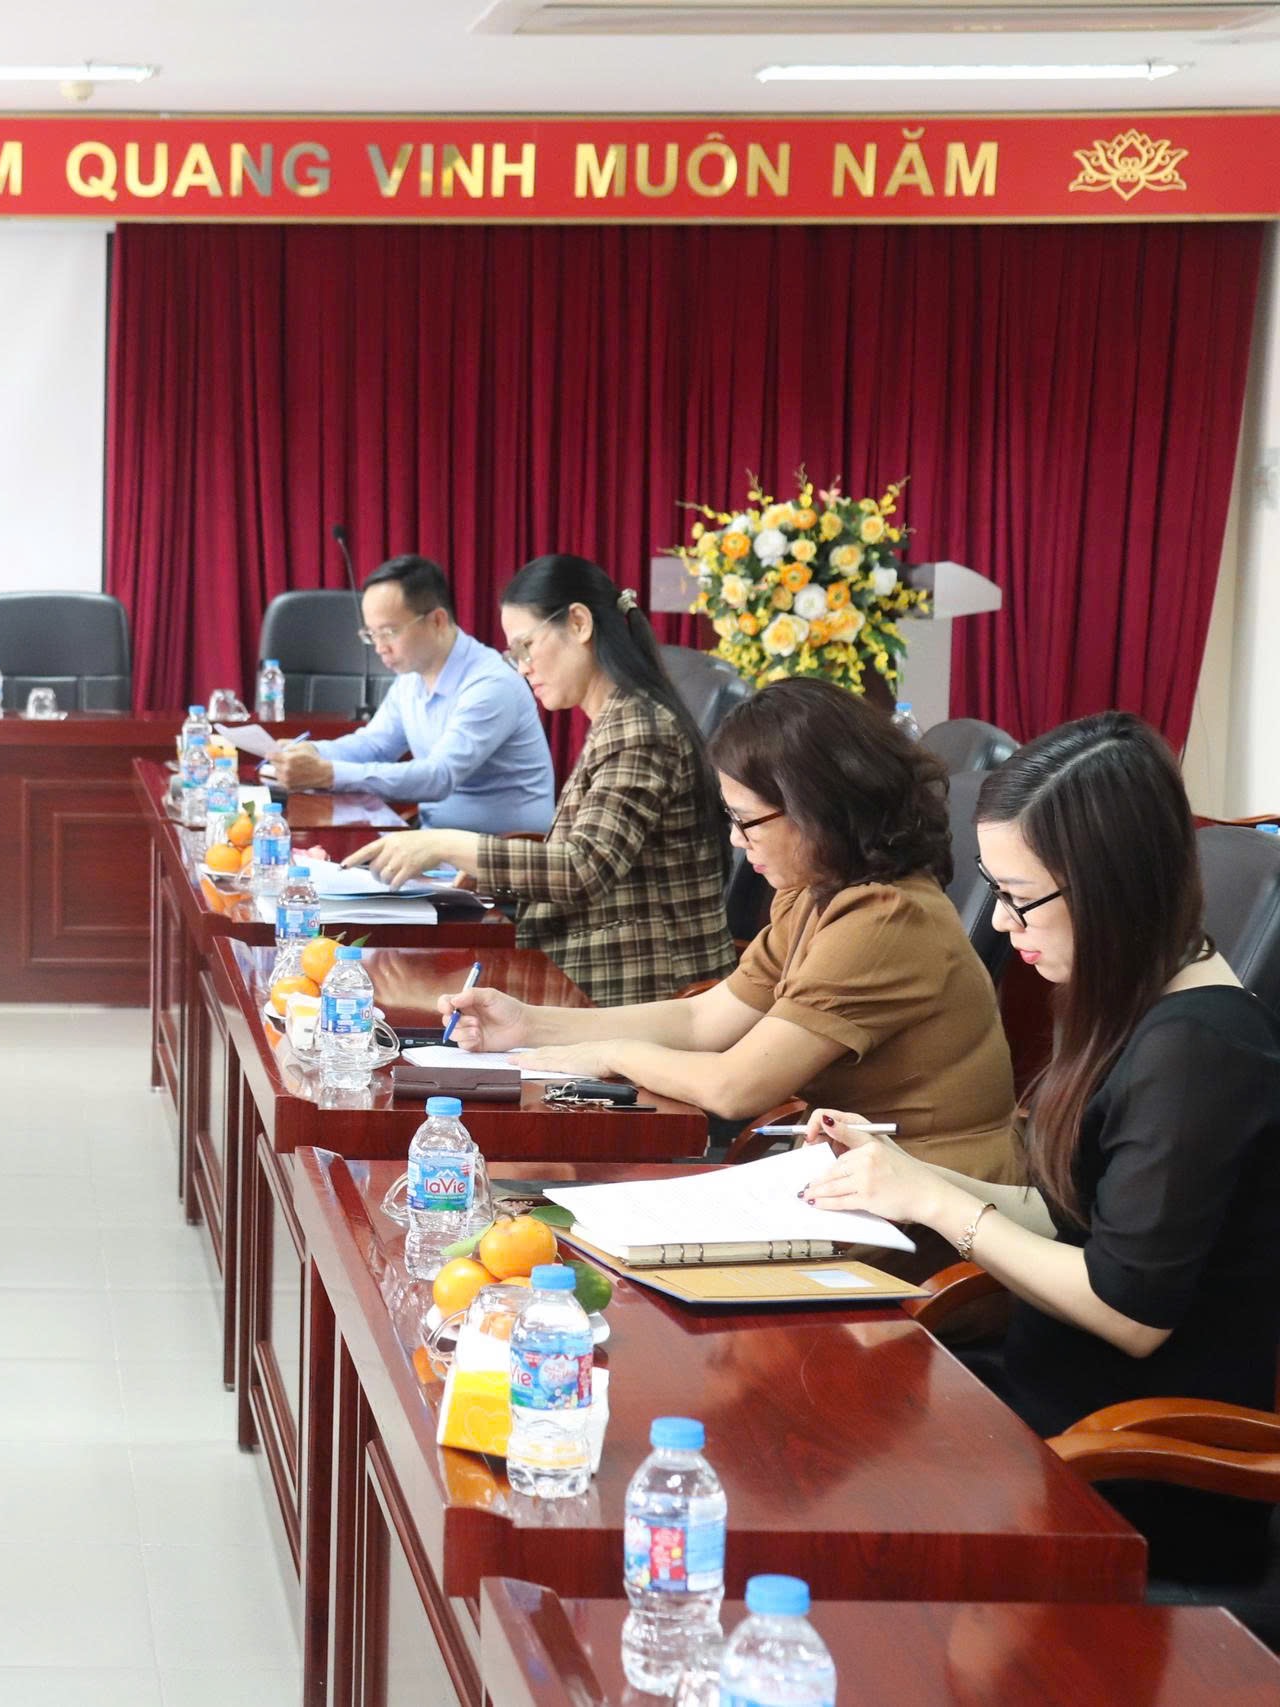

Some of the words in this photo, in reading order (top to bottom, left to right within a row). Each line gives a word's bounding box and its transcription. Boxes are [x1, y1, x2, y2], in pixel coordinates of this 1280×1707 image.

[65, 140, 330, 203] QUANG
[367, 141, 536, 199] VINH
[574, 131, 791, 199] MUÔN
[832, 126, 999, 198] NĂM
[424, 1177, 466, 1195] laVie
